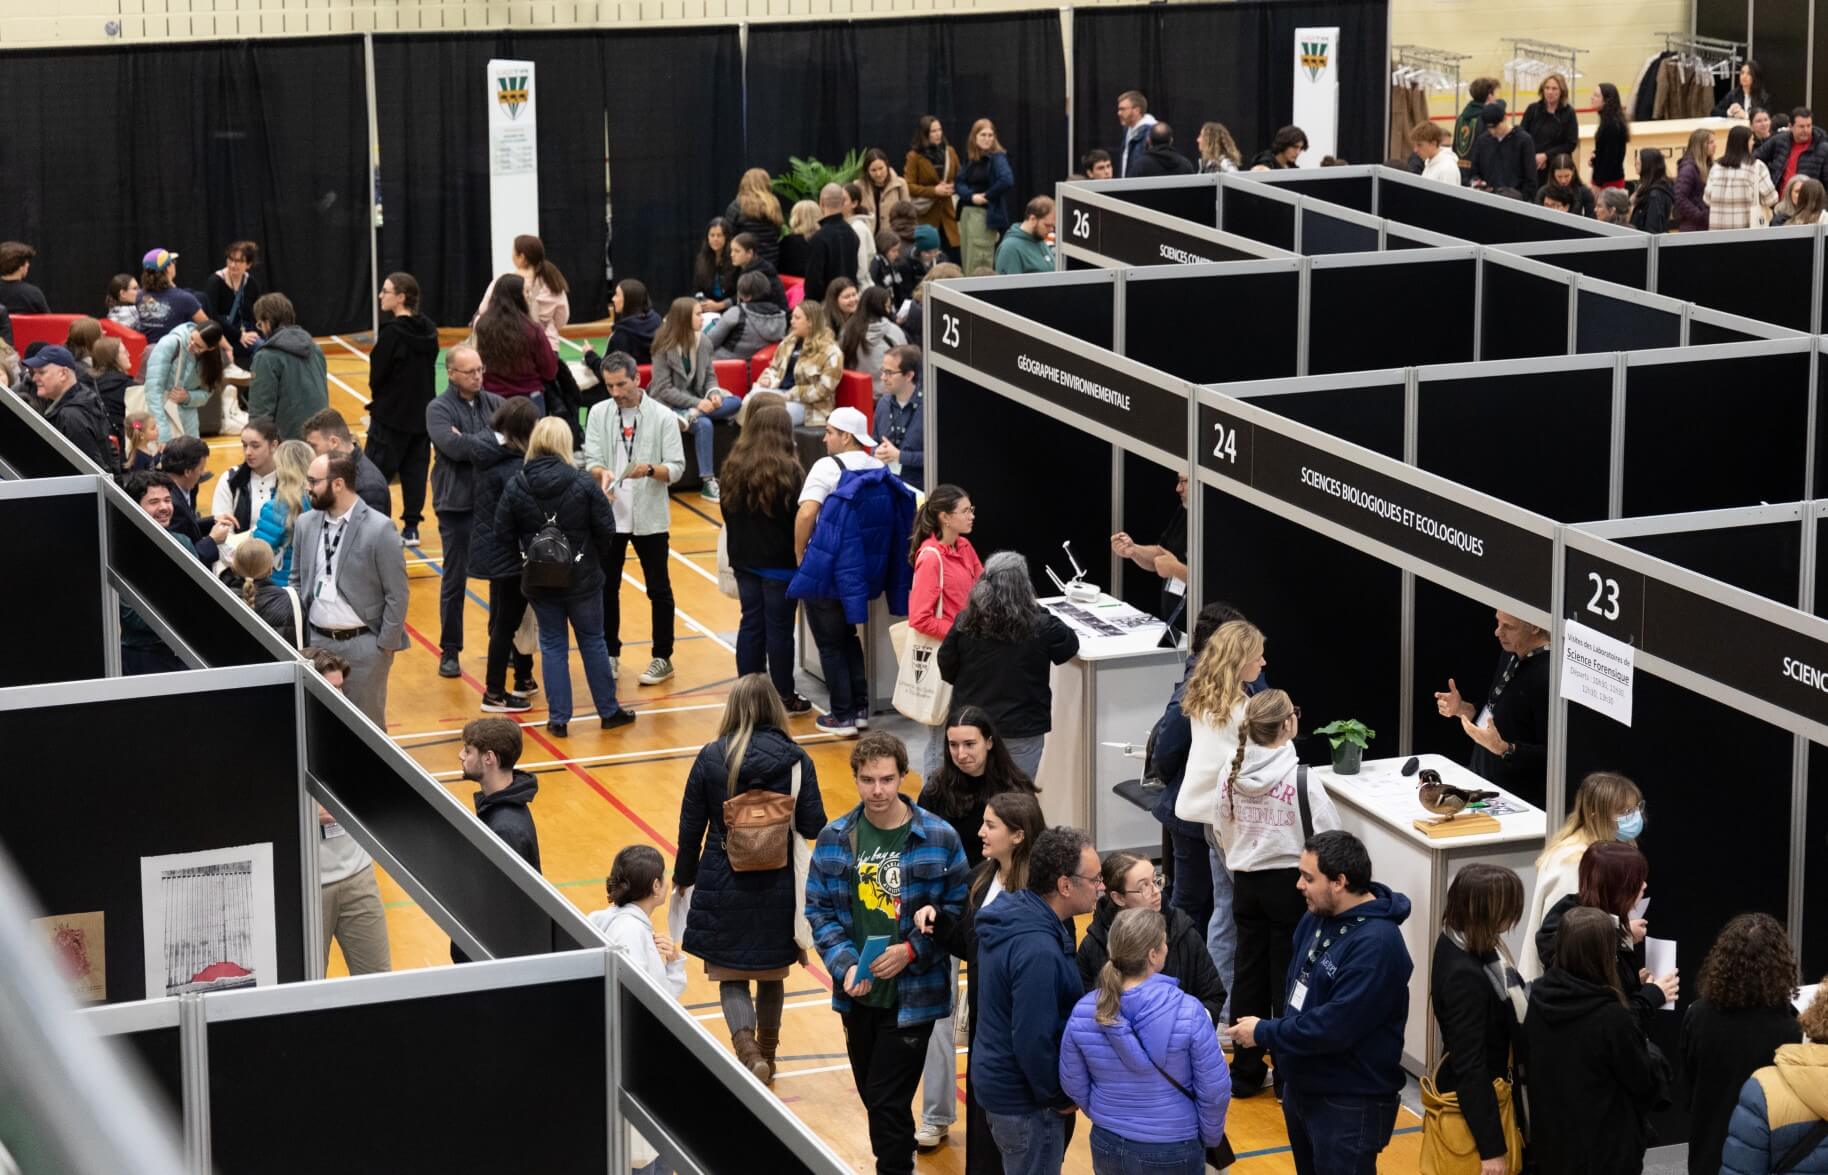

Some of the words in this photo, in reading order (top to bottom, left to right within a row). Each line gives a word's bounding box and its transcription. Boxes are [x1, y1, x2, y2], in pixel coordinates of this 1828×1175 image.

[1073, 209, 1090, 239] 26
[1159, 244, 1188, 265] SCIENCES
[942, 314, 960, 348] 25
[1017, 354, 1060, 383] GÉOGRAPHIE
[1060, 370, 1131, 411] ENVIRONNEMENTALE
[1213, 423, 1237, 464] 24
[1301, 466, 1341, 497] SCIENCES
[1341, 485, 1402, 523] BIOLOGIQUES
[1402, 509, 1415, 528] ET
[1415, 514, 1484, 557] ECOLOGIQUES
[1586, 572, 1620, 621] 23
[1567, 633, 1583, 646] Visites
[1583, 640, 1592, 650] des
[1593, 643, 1623, 663] Laboratoires
[1623, 657, 1631, 667] de
[1567, 647, 1591, 667] Science
[1593, 659, 1630, 684] Forensique
